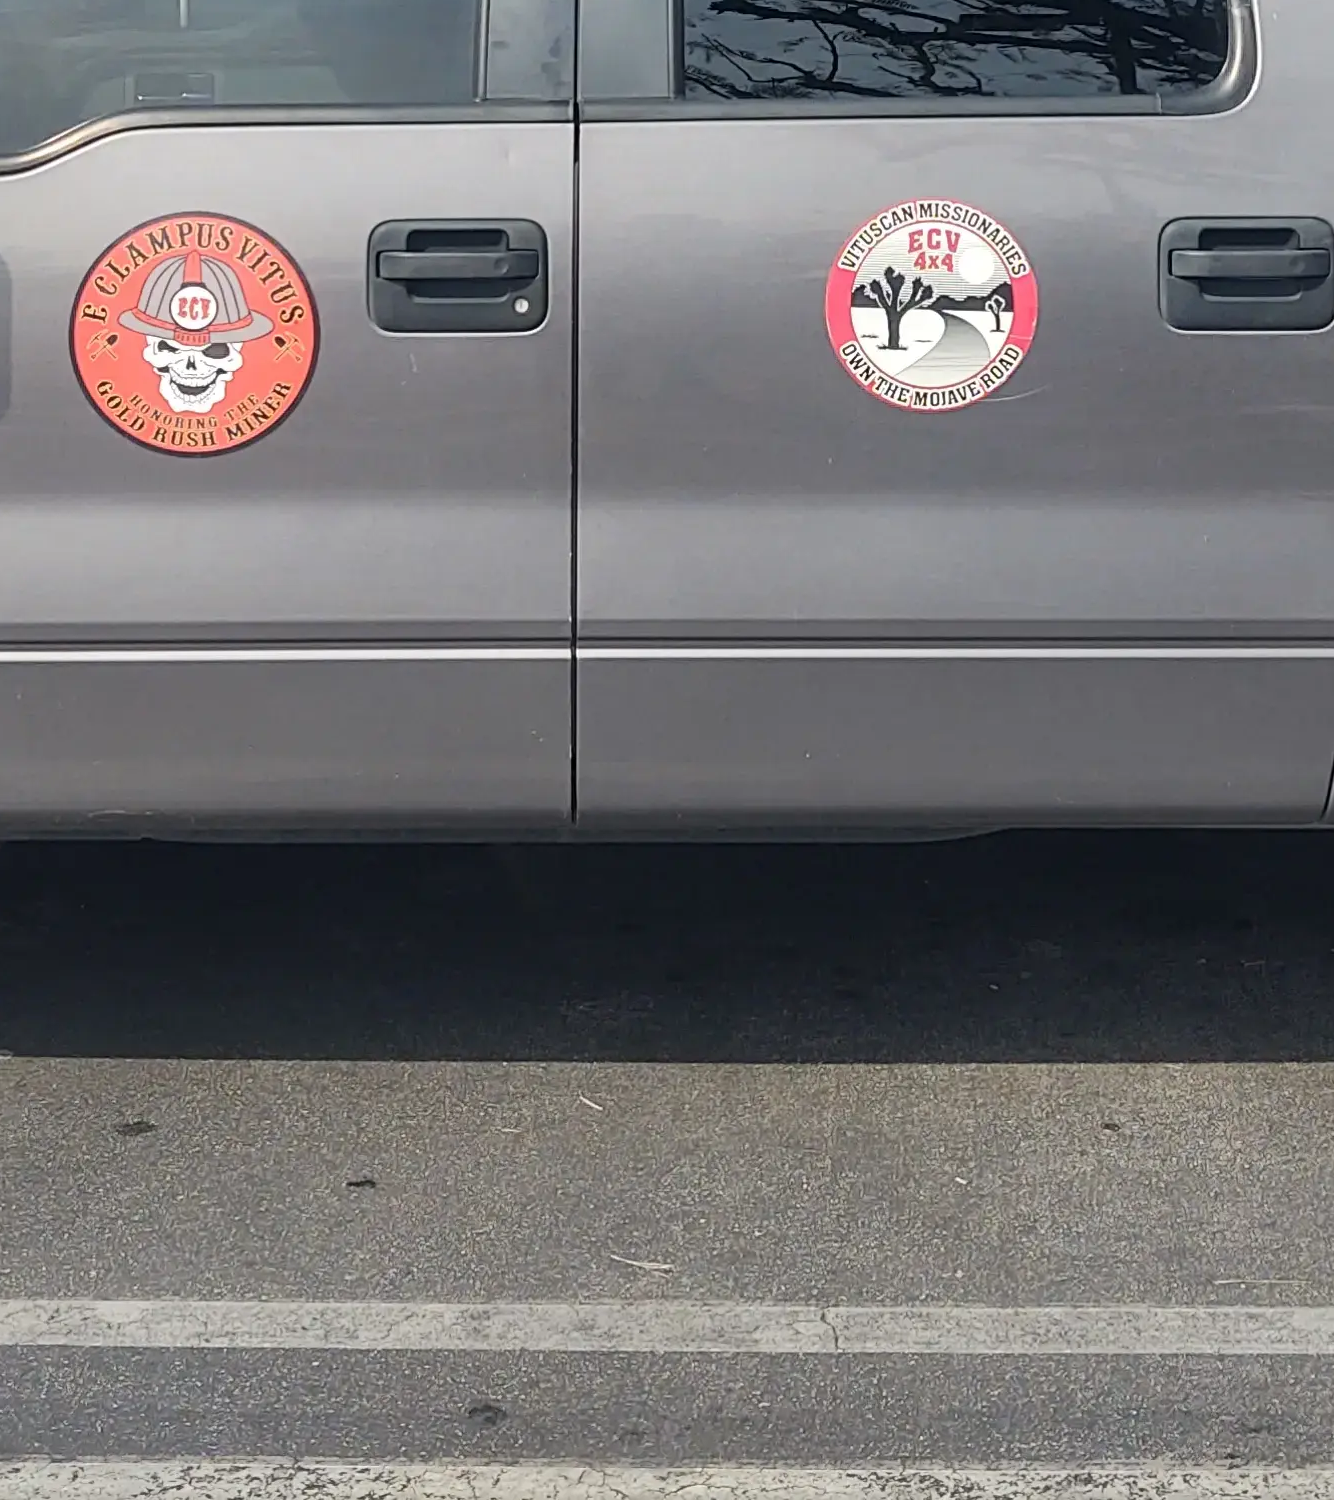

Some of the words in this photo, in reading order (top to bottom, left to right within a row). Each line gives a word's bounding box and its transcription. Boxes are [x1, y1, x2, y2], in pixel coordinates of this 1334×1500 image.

[840, 204, 915, 270] VITUSCAN
[919, 202, 1028, 276] MISSIONARIES
[907, 229, 960, 253] ECV
[81, 304, 107, 324] E
[94, 221, 234, 296] CLAMPUS
[236, 235, 305, 324] VITUS
[842, 343, 875, 383] OWN
[875, 376, 910, 403] THE
[913, 383, 981, 407] MOJAVE
[983, 348, 1021, 391] ROAD
[96, 379, 146, 433] GOLD
[152, 427, 217, 447] RUSH
[226, 381, 292, 441] MINER
[129, 394, 218, 429] HONORING
[224, 393, 260, 422] THE
